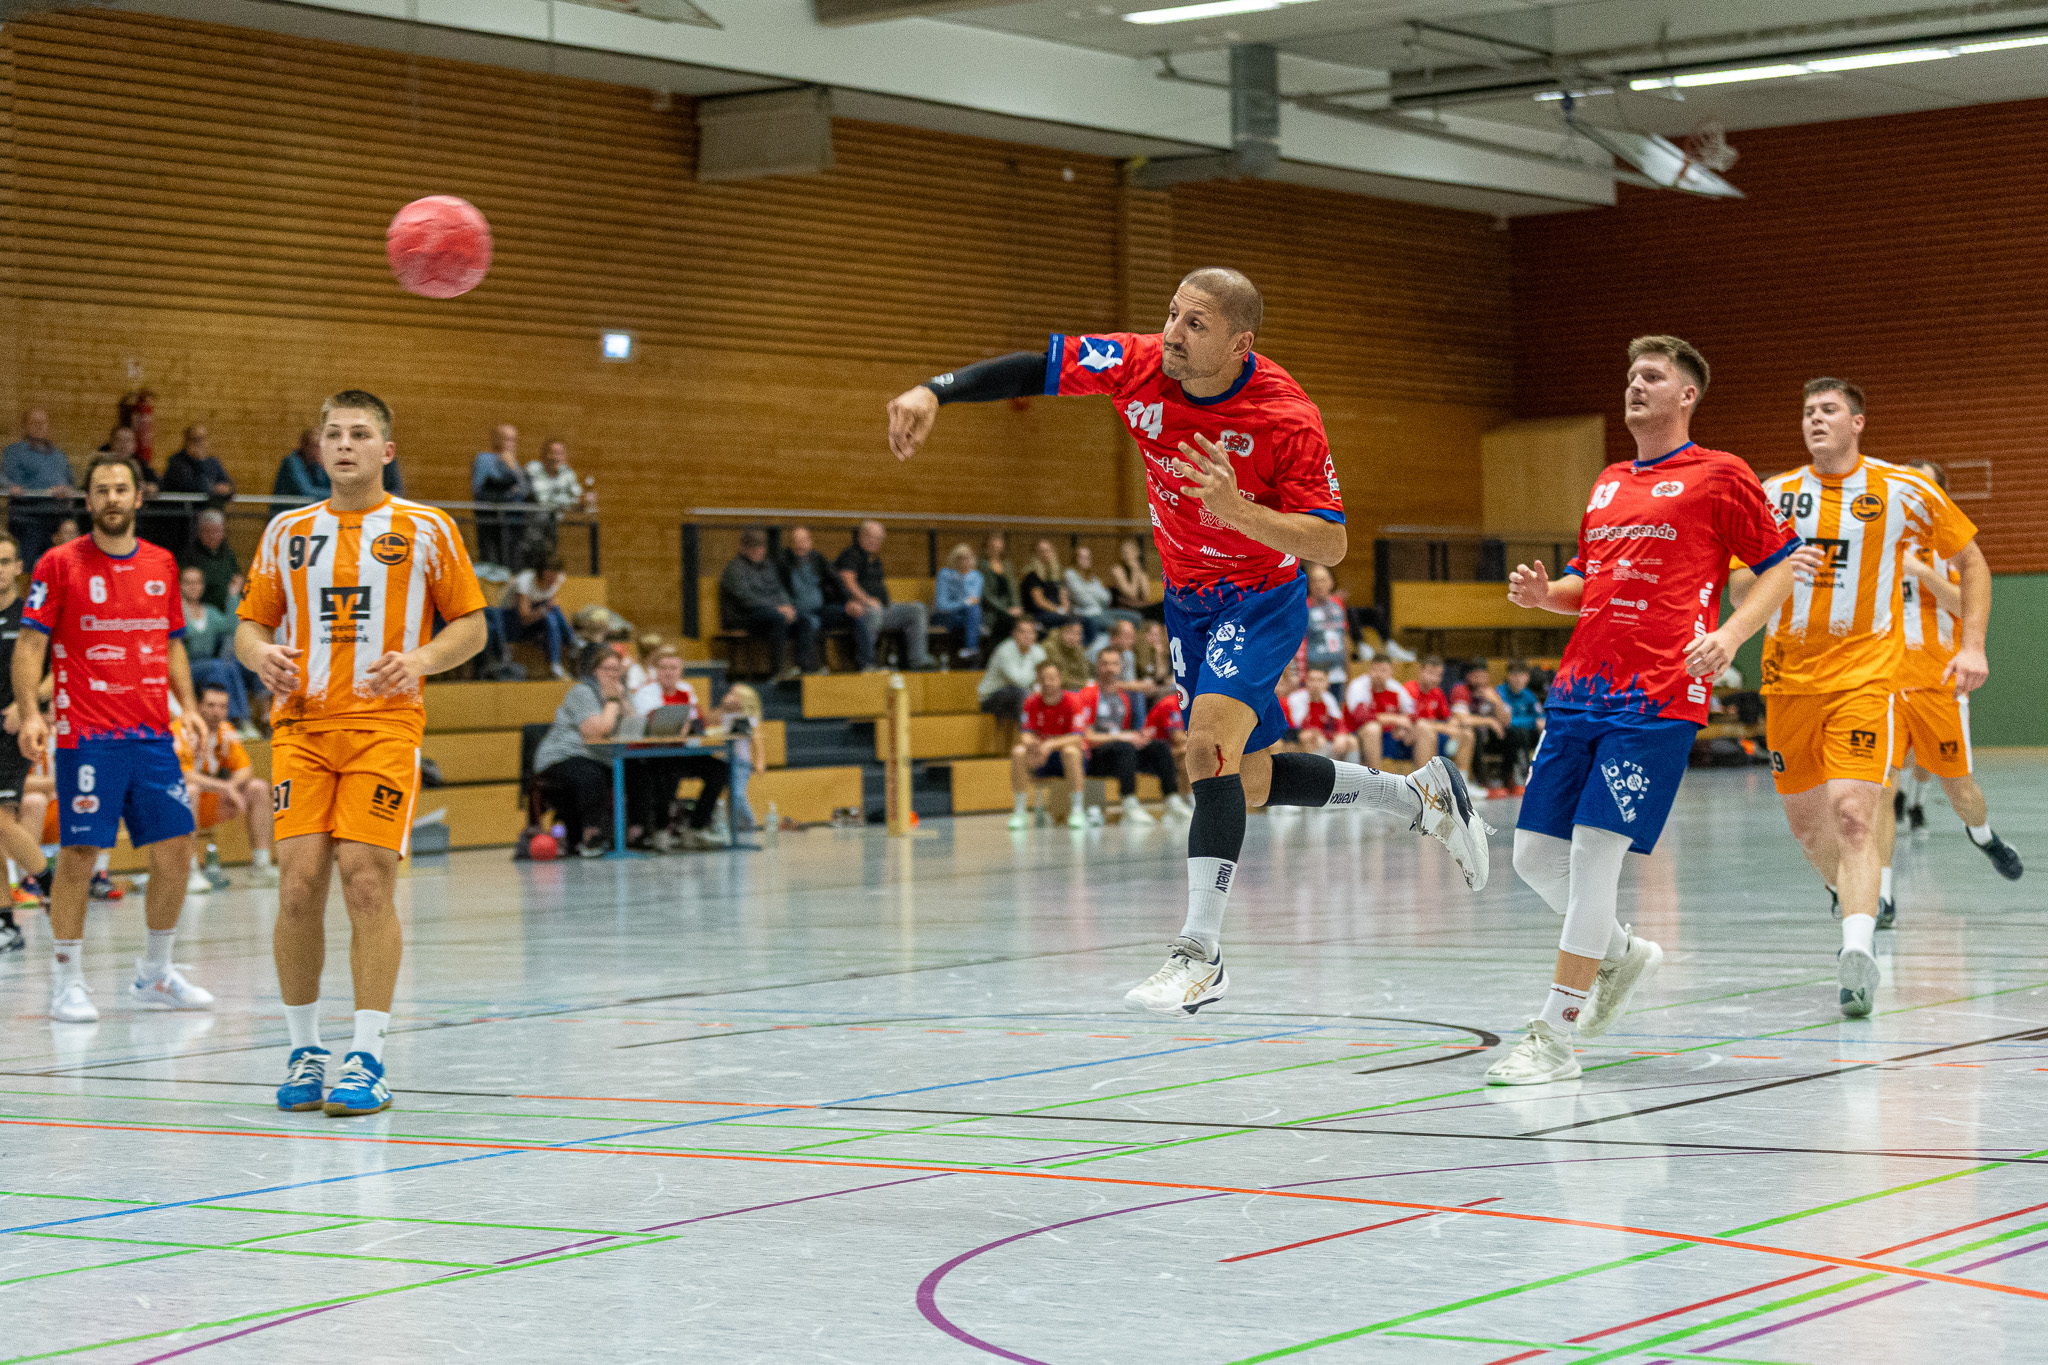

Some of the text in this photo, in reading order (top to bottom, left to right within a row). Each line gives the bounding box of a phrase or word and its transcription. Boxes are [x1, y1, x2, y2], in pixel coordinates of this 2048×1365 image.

[1780, 492, 1813, 519] 99
[289, 535, 329, 570] 97
[88, 575, 107, 604] 6
[78, 764, 96, 793] 6
[1214, 863, 1234, 894] ATORKA
